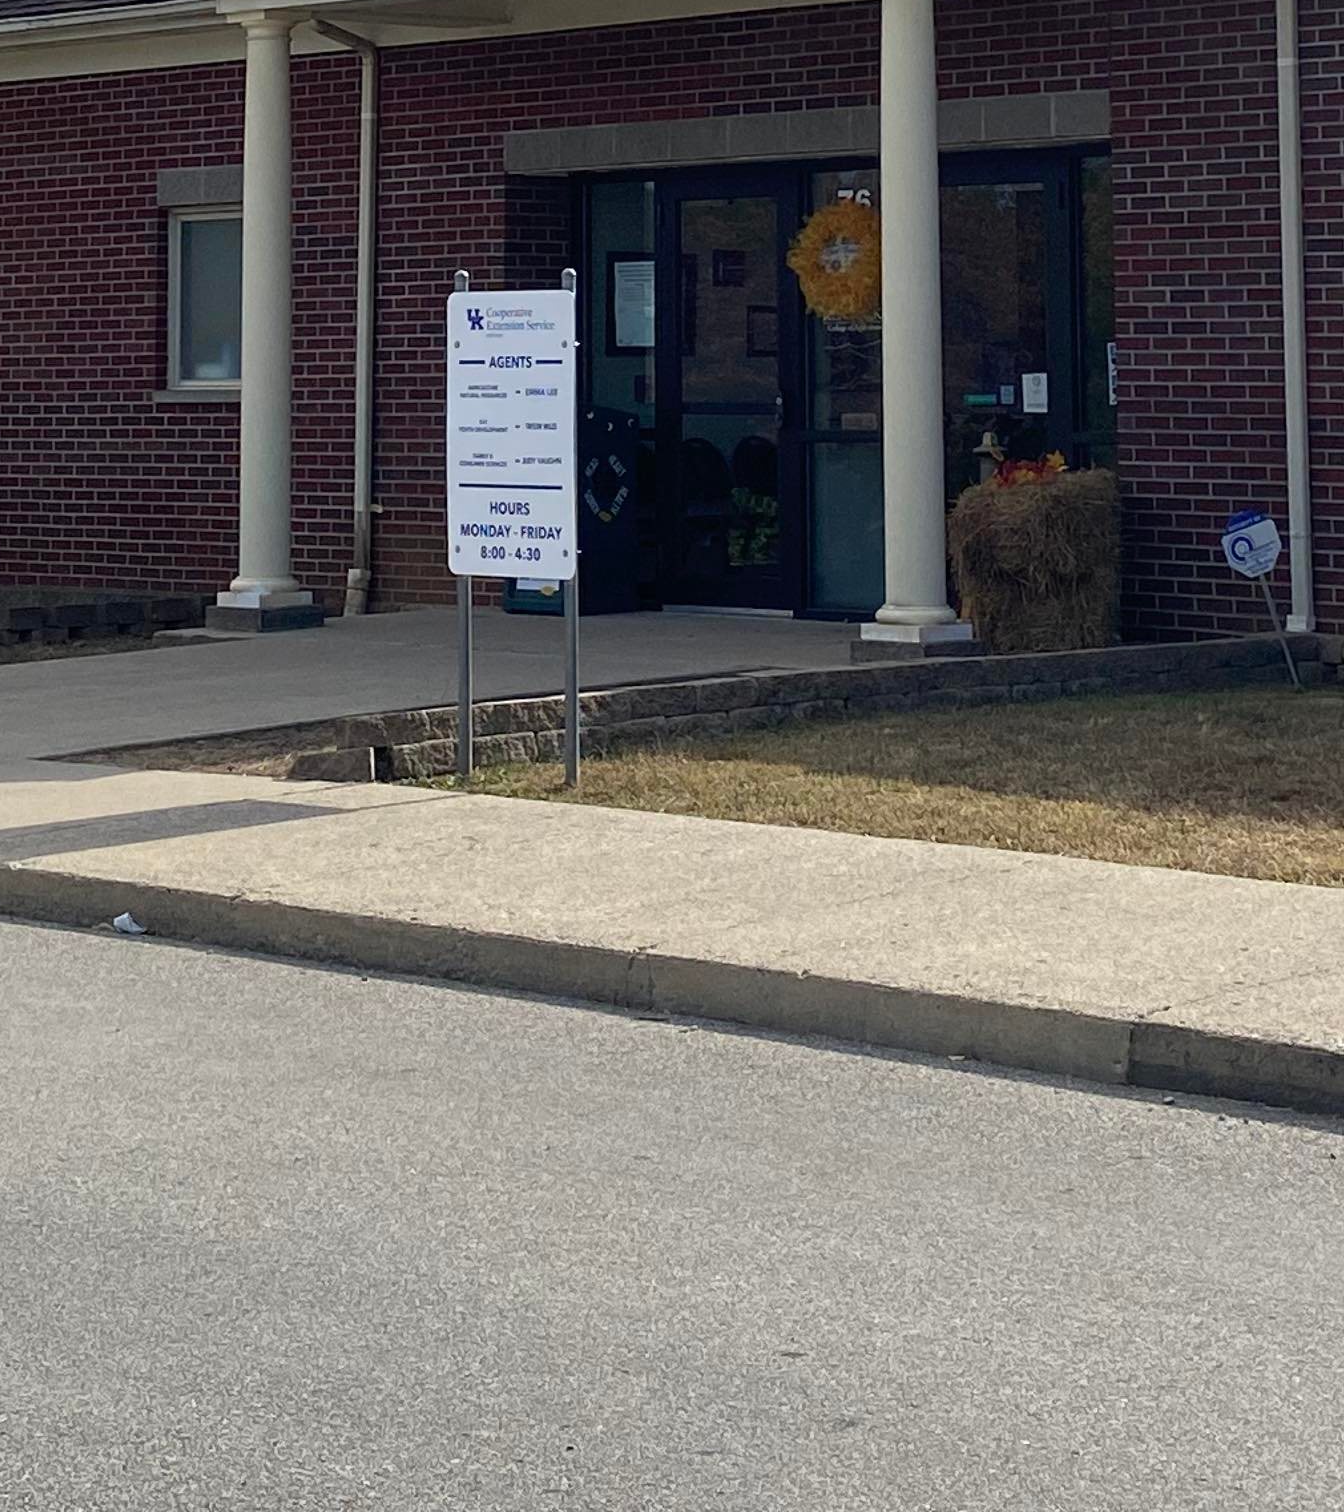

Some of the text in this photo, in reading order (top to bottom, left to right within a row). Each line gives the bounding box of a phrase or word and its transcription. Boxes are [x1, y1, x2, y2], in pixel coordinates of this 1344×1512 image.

[485, 307, 533, 320] Cooperative
[486, 320, 556, 331] Extension Service
[489, 356, 533, 369] AGENTS
[489, 501, 531, 516] HOURS
[460, 523, 512, 538] MONDAY
[520, 525, 563, 541] FRIDAY
[480, 545, 506, 560] 8:00
[515, 546, 542, 561] 4:30
